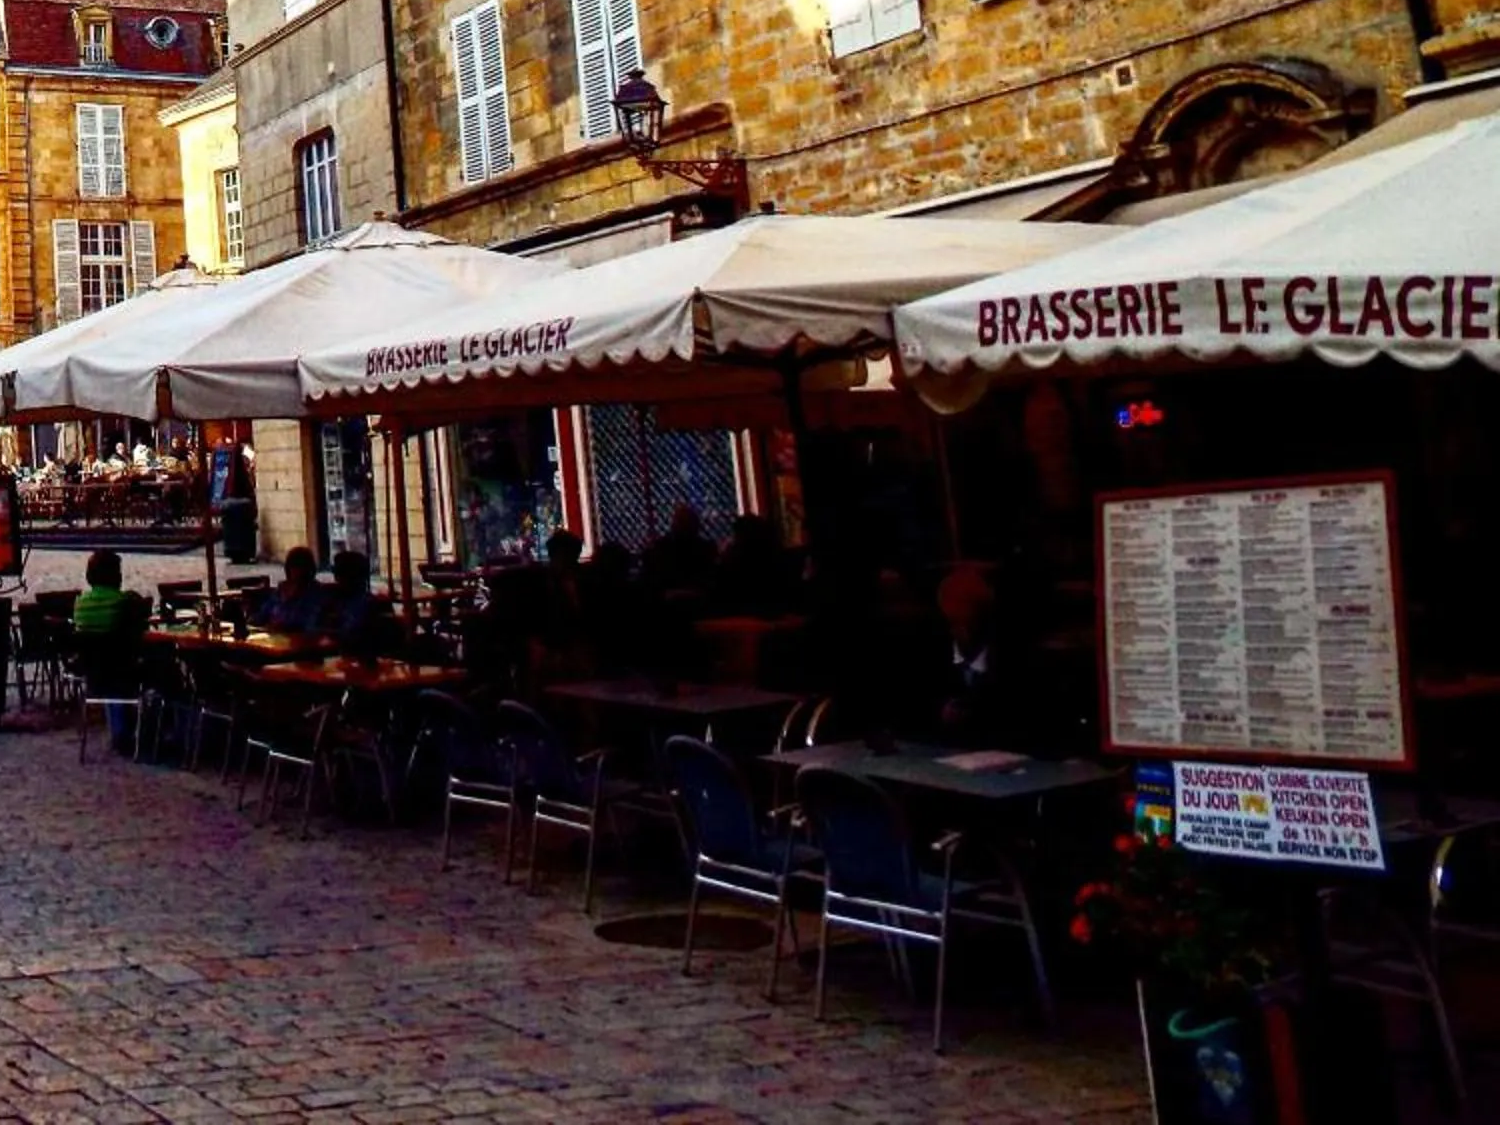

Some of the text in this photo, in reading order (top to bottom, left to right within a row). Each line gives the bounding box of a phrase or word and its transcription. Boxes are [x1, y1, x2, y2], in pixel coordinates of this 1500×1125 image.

[977, 275, 1500, 348] BRASSERIE LE GLACIE
[365, 316, 575, 376] BRASSERIE LE GLACIER
[1180, 766, 1266, 792] SUGGESTION
[1267, 772, 1365, 793] CUISINE OUVERTE
[1182, 789, 1241, 811] DU JOUR
[1271, 790, 1368, 811] KITCHEN OPEN
[1275, 807, 1370, 829] KEUKEN OPEN
[1277, 840, 1378, 862] SERVICE NON STOP
